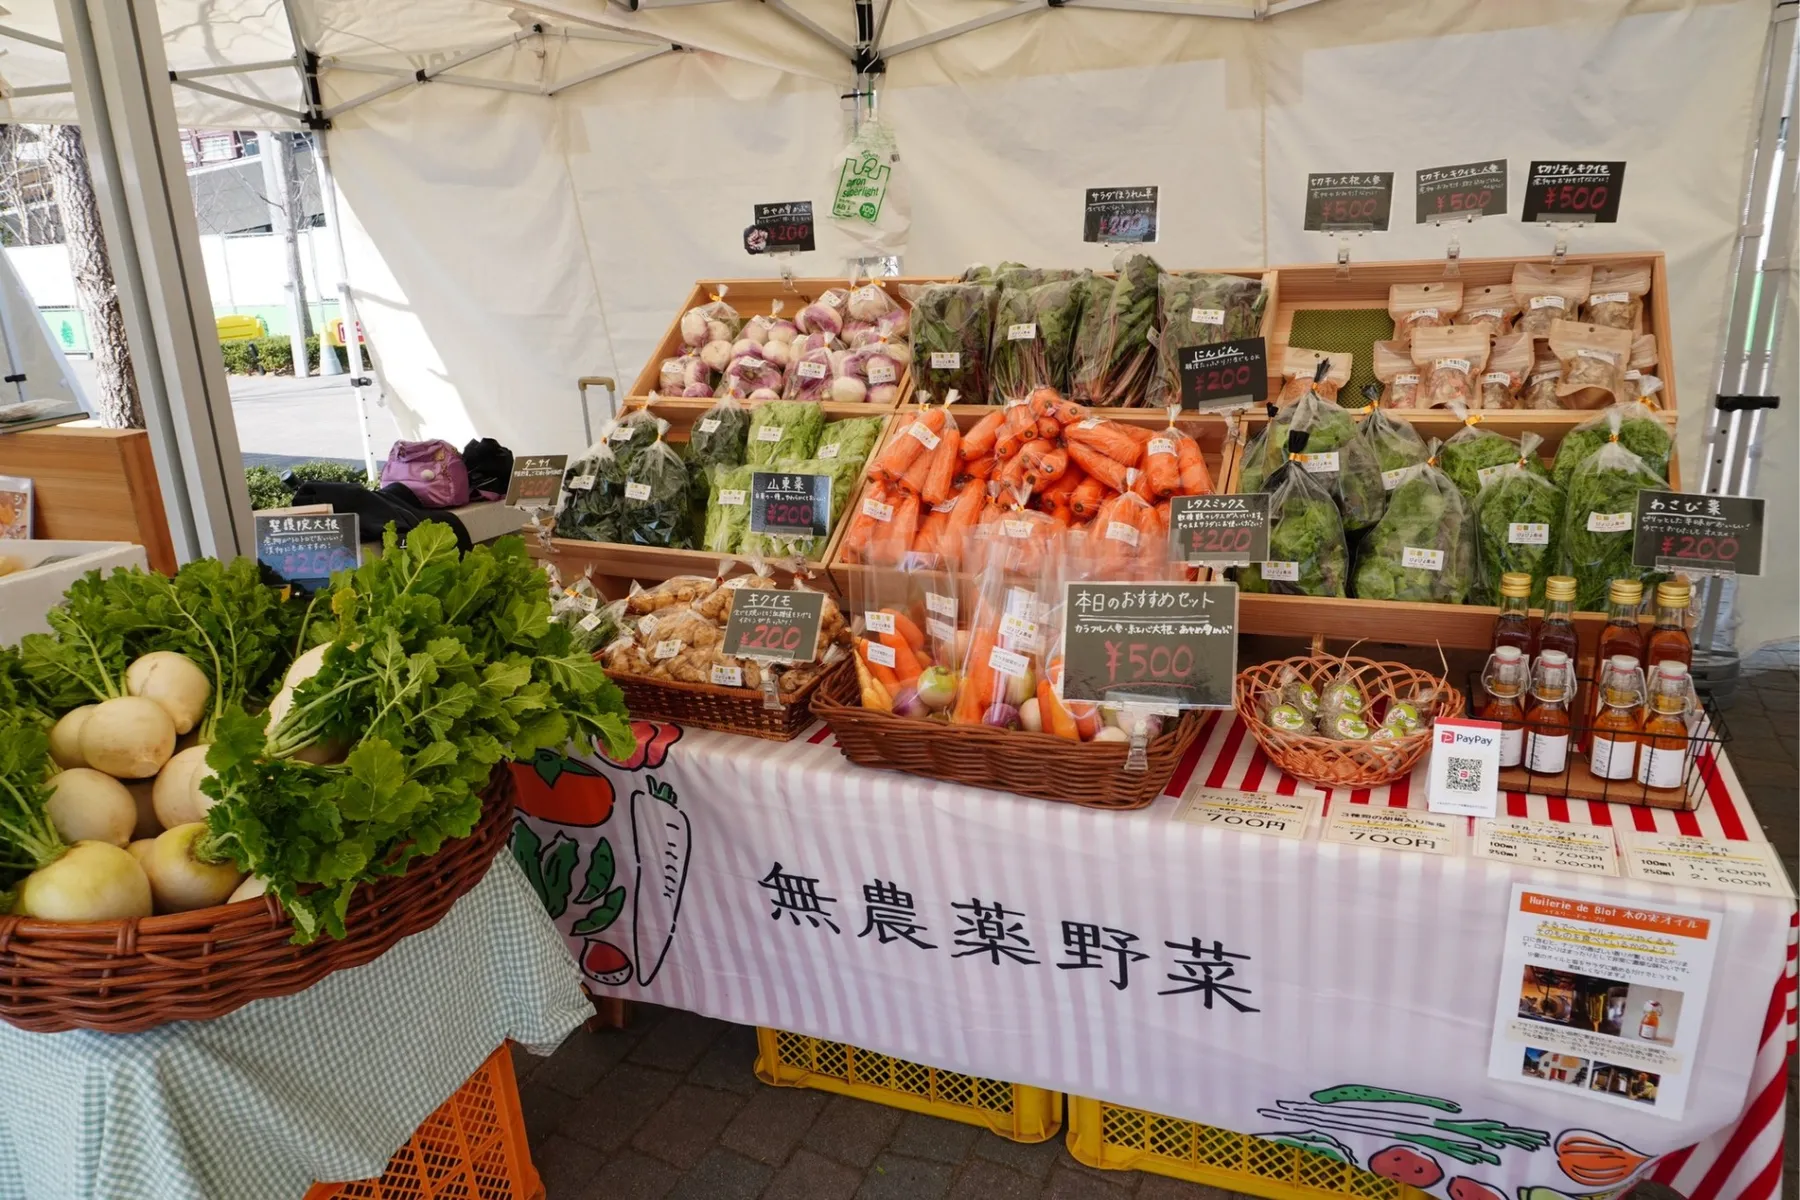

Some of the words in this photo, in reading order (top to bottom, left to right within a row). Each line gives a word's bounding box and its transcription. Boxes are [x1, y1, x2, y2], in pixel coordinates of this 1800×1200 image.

[1436, 190, 1493, 213] ¥500
[1544, 184, 1608, 211] ¥500
[1322, 198, 1378, 221] ¥500
[769, 224, 809, 241] ¥200
[1194, 345, 1240, 360] にんじん
[1194, 365, 1251, 394] ¥200
[766, 476, 804, 491] 山東菜
[767, 503, 813, 525] ¥200
[1187, 498, 1246, 510] レタスミックス
[268, 517, 341, 533] 聖護院大根
[1191, 527, 1253, 552] ¥200
[1661, 535, 1739, 560] ¥200
[283, 548, 346, 574] ¥200
[748, 593, 792, 606] キクイモ
[1074, 589, 1215, 614] 本日のおすすめセット
[740, 624, 802, 650] ¥200
[1104, 639, 1194, 682] ¥500
[1456, 733, 1493, 746] PayPay
[1206, 812, 1286, 831] 700円
[1349, 831, 1436, 850] 700円
[1490, 841, 1518, 850] 100ml
[1641, 859, 1672, 868] 100ml
[1529, 895, 1572, 911] Huilerie
[1576, 903, 1589, 913] de
[1622, 910, 1699, 929] 木の実オイル
[757, 861, 1261, 1013] 無農薬野菜
